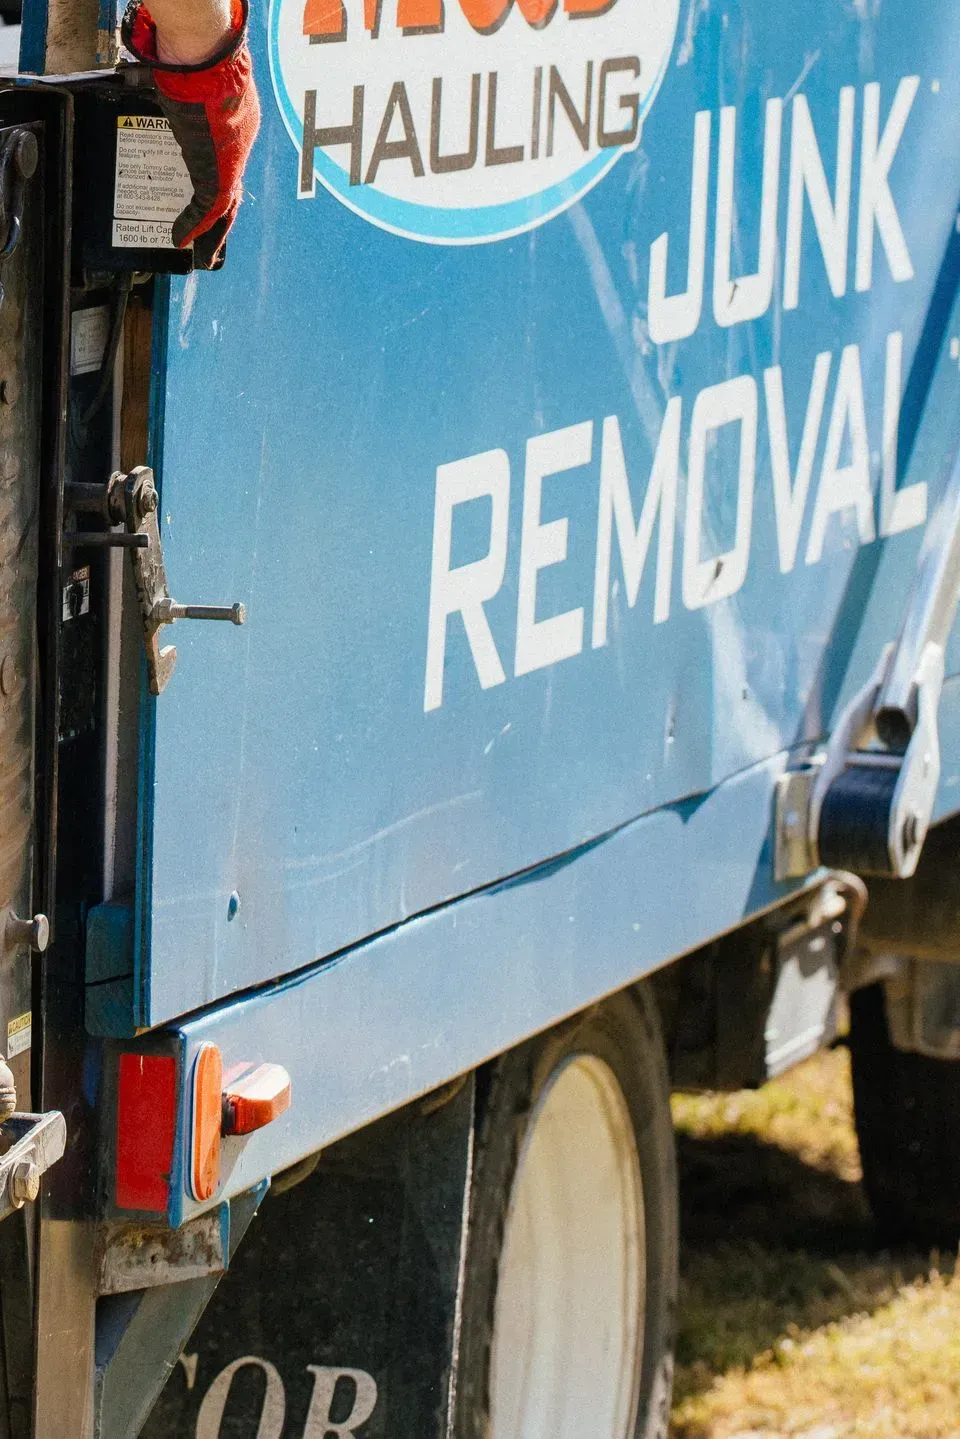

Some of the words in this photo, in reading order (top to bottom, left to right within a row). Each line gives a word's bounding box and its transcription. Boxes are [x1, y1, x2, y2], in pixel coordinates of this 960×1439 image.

[300, 55, 641, 193] HAULING
[116, 223, 139, 233] Rated
[142, 225, 154, 233] Lift
[120, 234, 138, 242] 1600
[140, 235, 147, 243] lb
[160, 236, 173, 244] 73
[648, 75, 920, 345] JUNK
[424, 331, 927, 712] REMOVAL
[179, 1352, 378, 1439] OR
